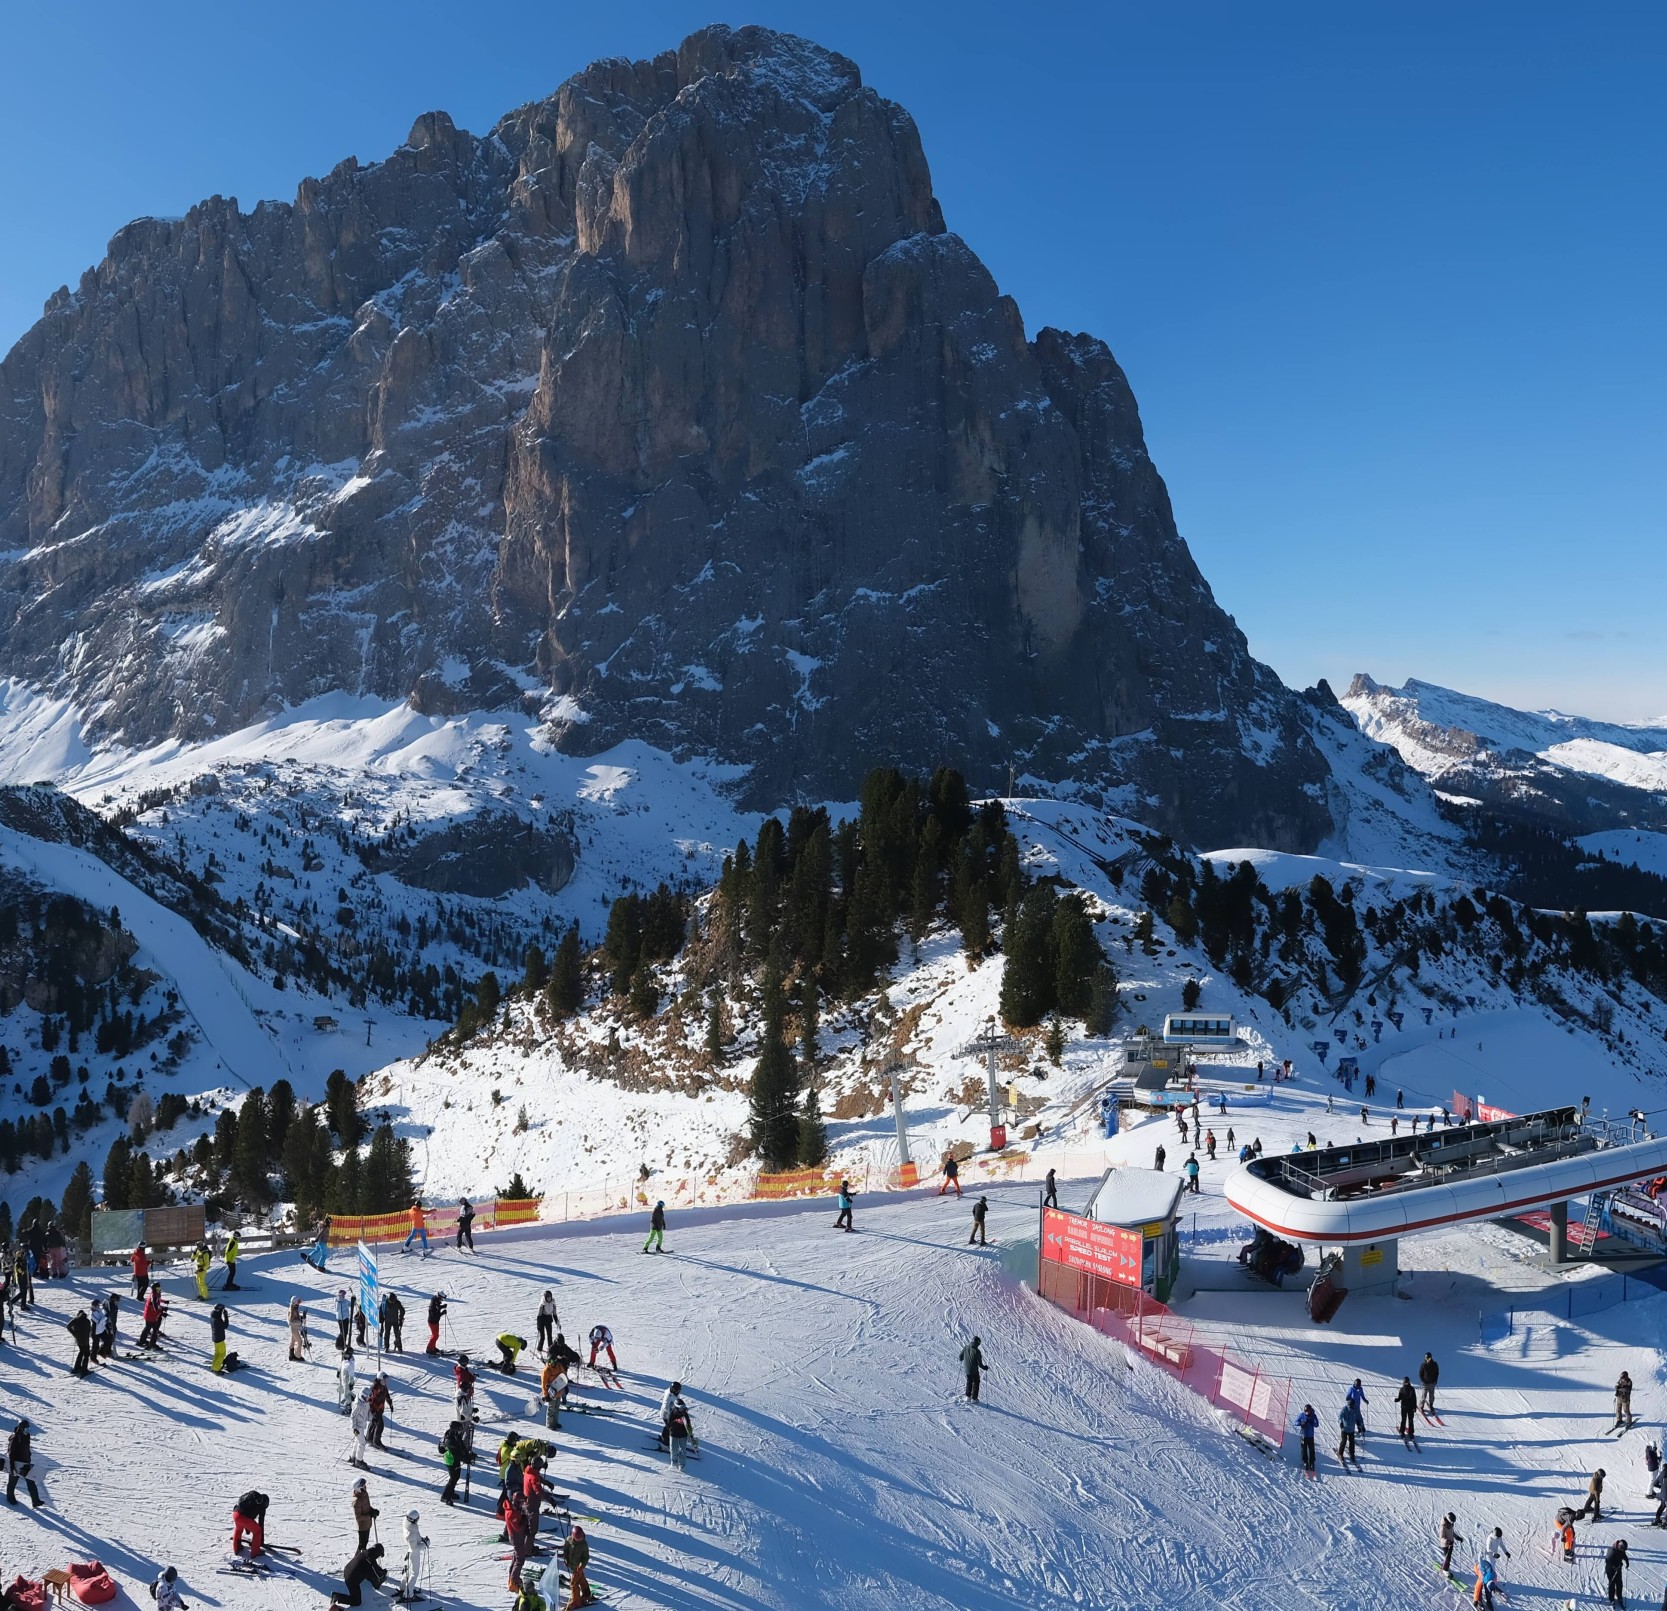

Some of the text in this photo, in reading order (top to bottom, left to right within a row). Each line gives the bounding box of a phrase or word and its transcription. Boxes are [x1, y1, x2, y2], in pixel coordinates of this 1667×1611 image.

[1069, 1216, 1088, 1228] TREMOR
[1064, 1236, 1118, 1258] PARALLEL SLALOM
[1069, 1244, 1112, 1262] SPEED TEST
